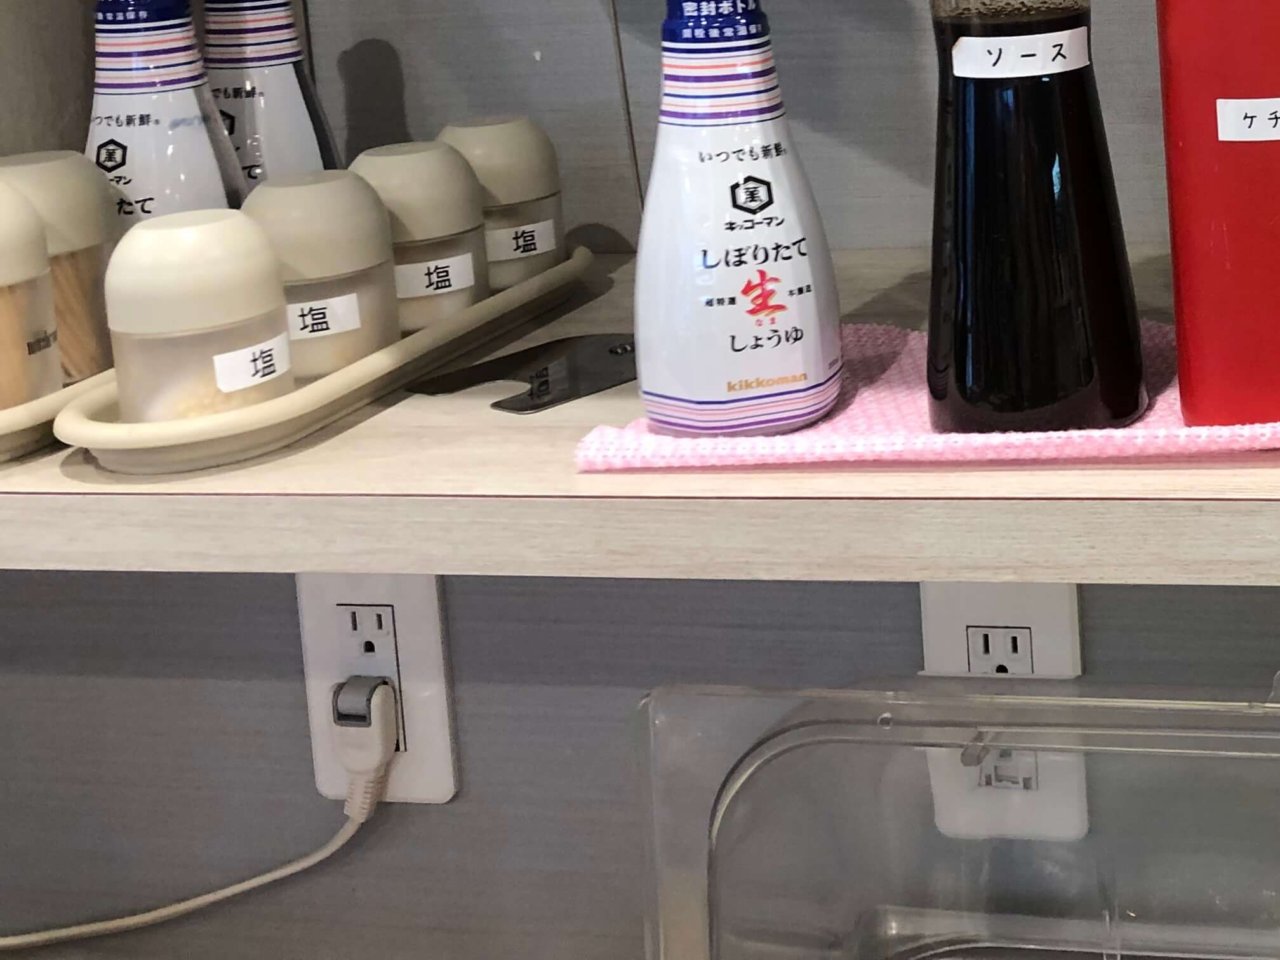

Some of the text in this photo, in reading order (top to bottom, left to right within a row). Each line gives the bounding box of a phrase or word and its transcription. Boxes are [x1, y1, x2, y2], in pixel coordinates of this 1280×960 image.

[987, 43, 1067, 67] ソース
[724, 217, 785, 231] キッコーマン
[512, 230, 538, 254] 塩
[702, 237, 808, 269] しぼりたて
[424, 265, 452, 291] 塩
[741, 269, 787, 316] 生
[298, 306, 331, 333] 塩
[730, 327, 804, 352] しょうゆ
[250, 348, 276, 378] 塩
[727, 371, 808, 393] kikkoman
